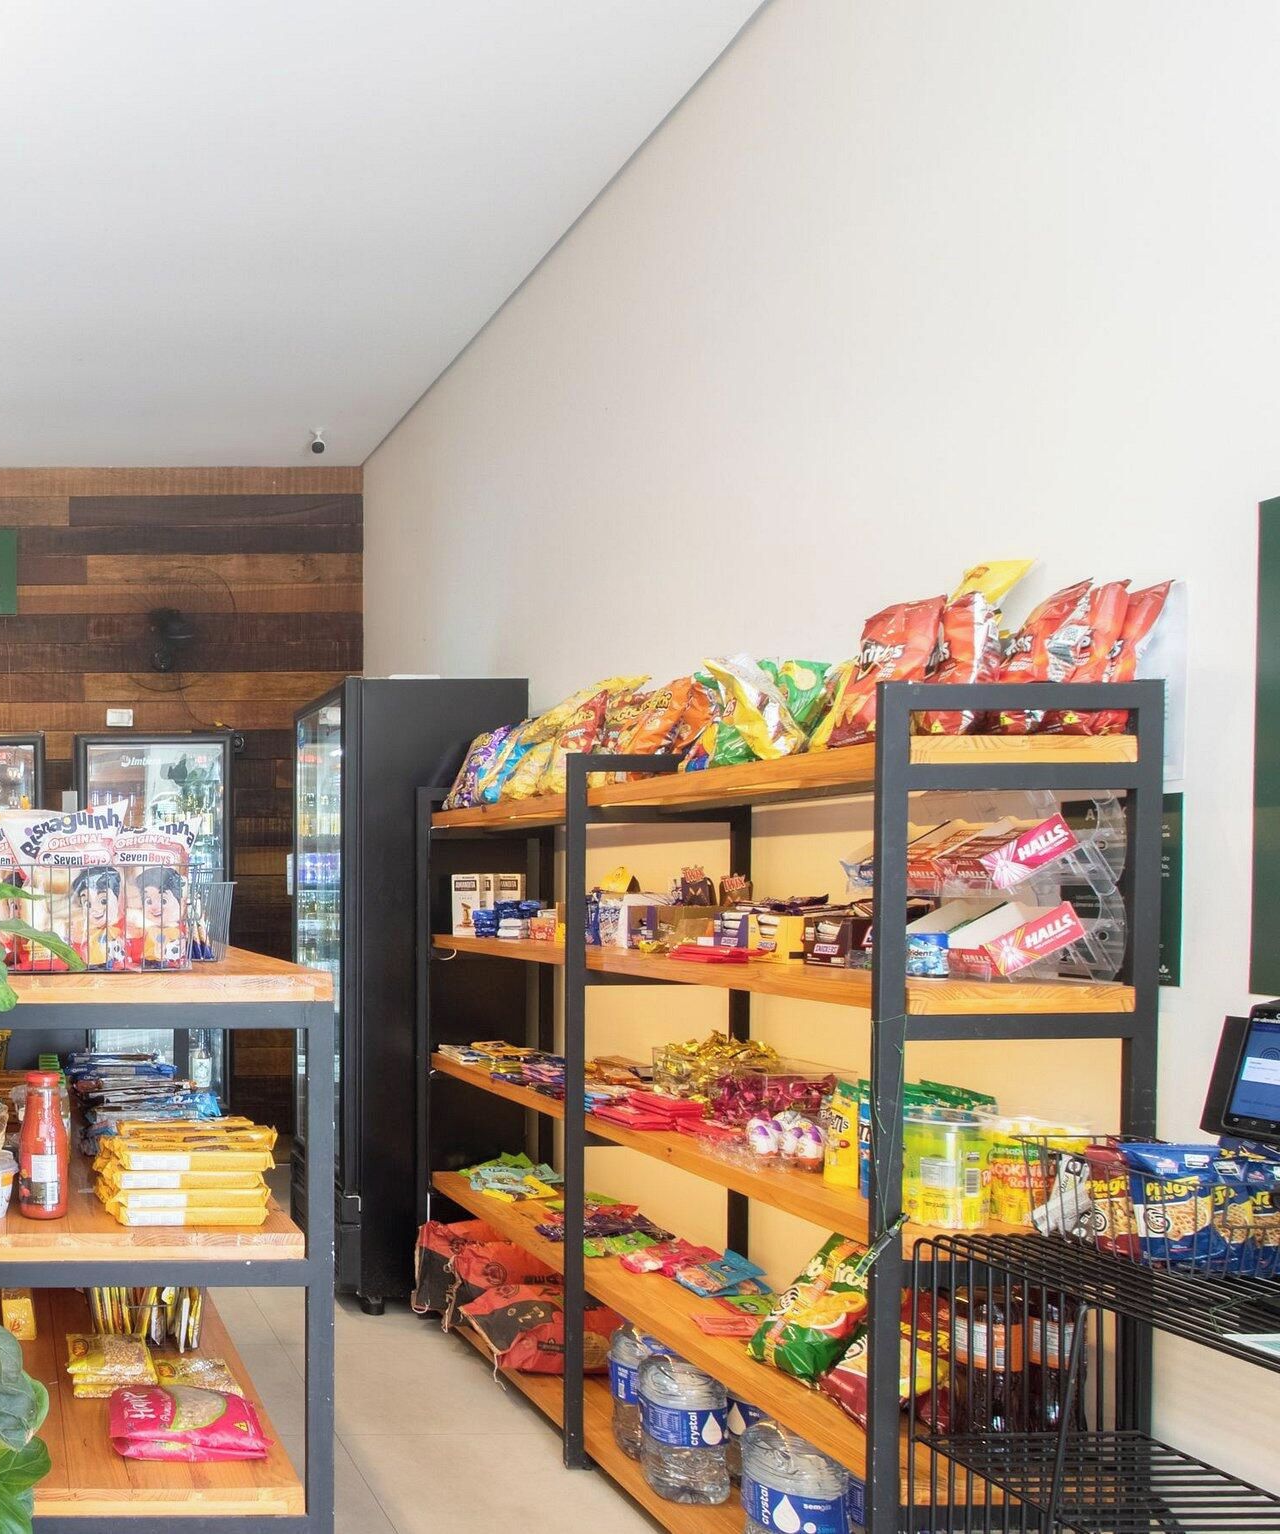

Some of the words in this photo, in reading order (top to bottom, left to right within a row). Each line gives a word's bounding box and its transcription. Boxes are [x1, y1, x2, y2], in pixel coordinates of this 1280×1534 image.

[20, 806, 121, 859] Bisnaguinh
[49, 833, 104, 851] ORIGINAL
[114, 835, 171, 850] ORIGINAL
[688, 1412, 701, 1446] crystal
[759, 1484, 771, 1526] crystal
